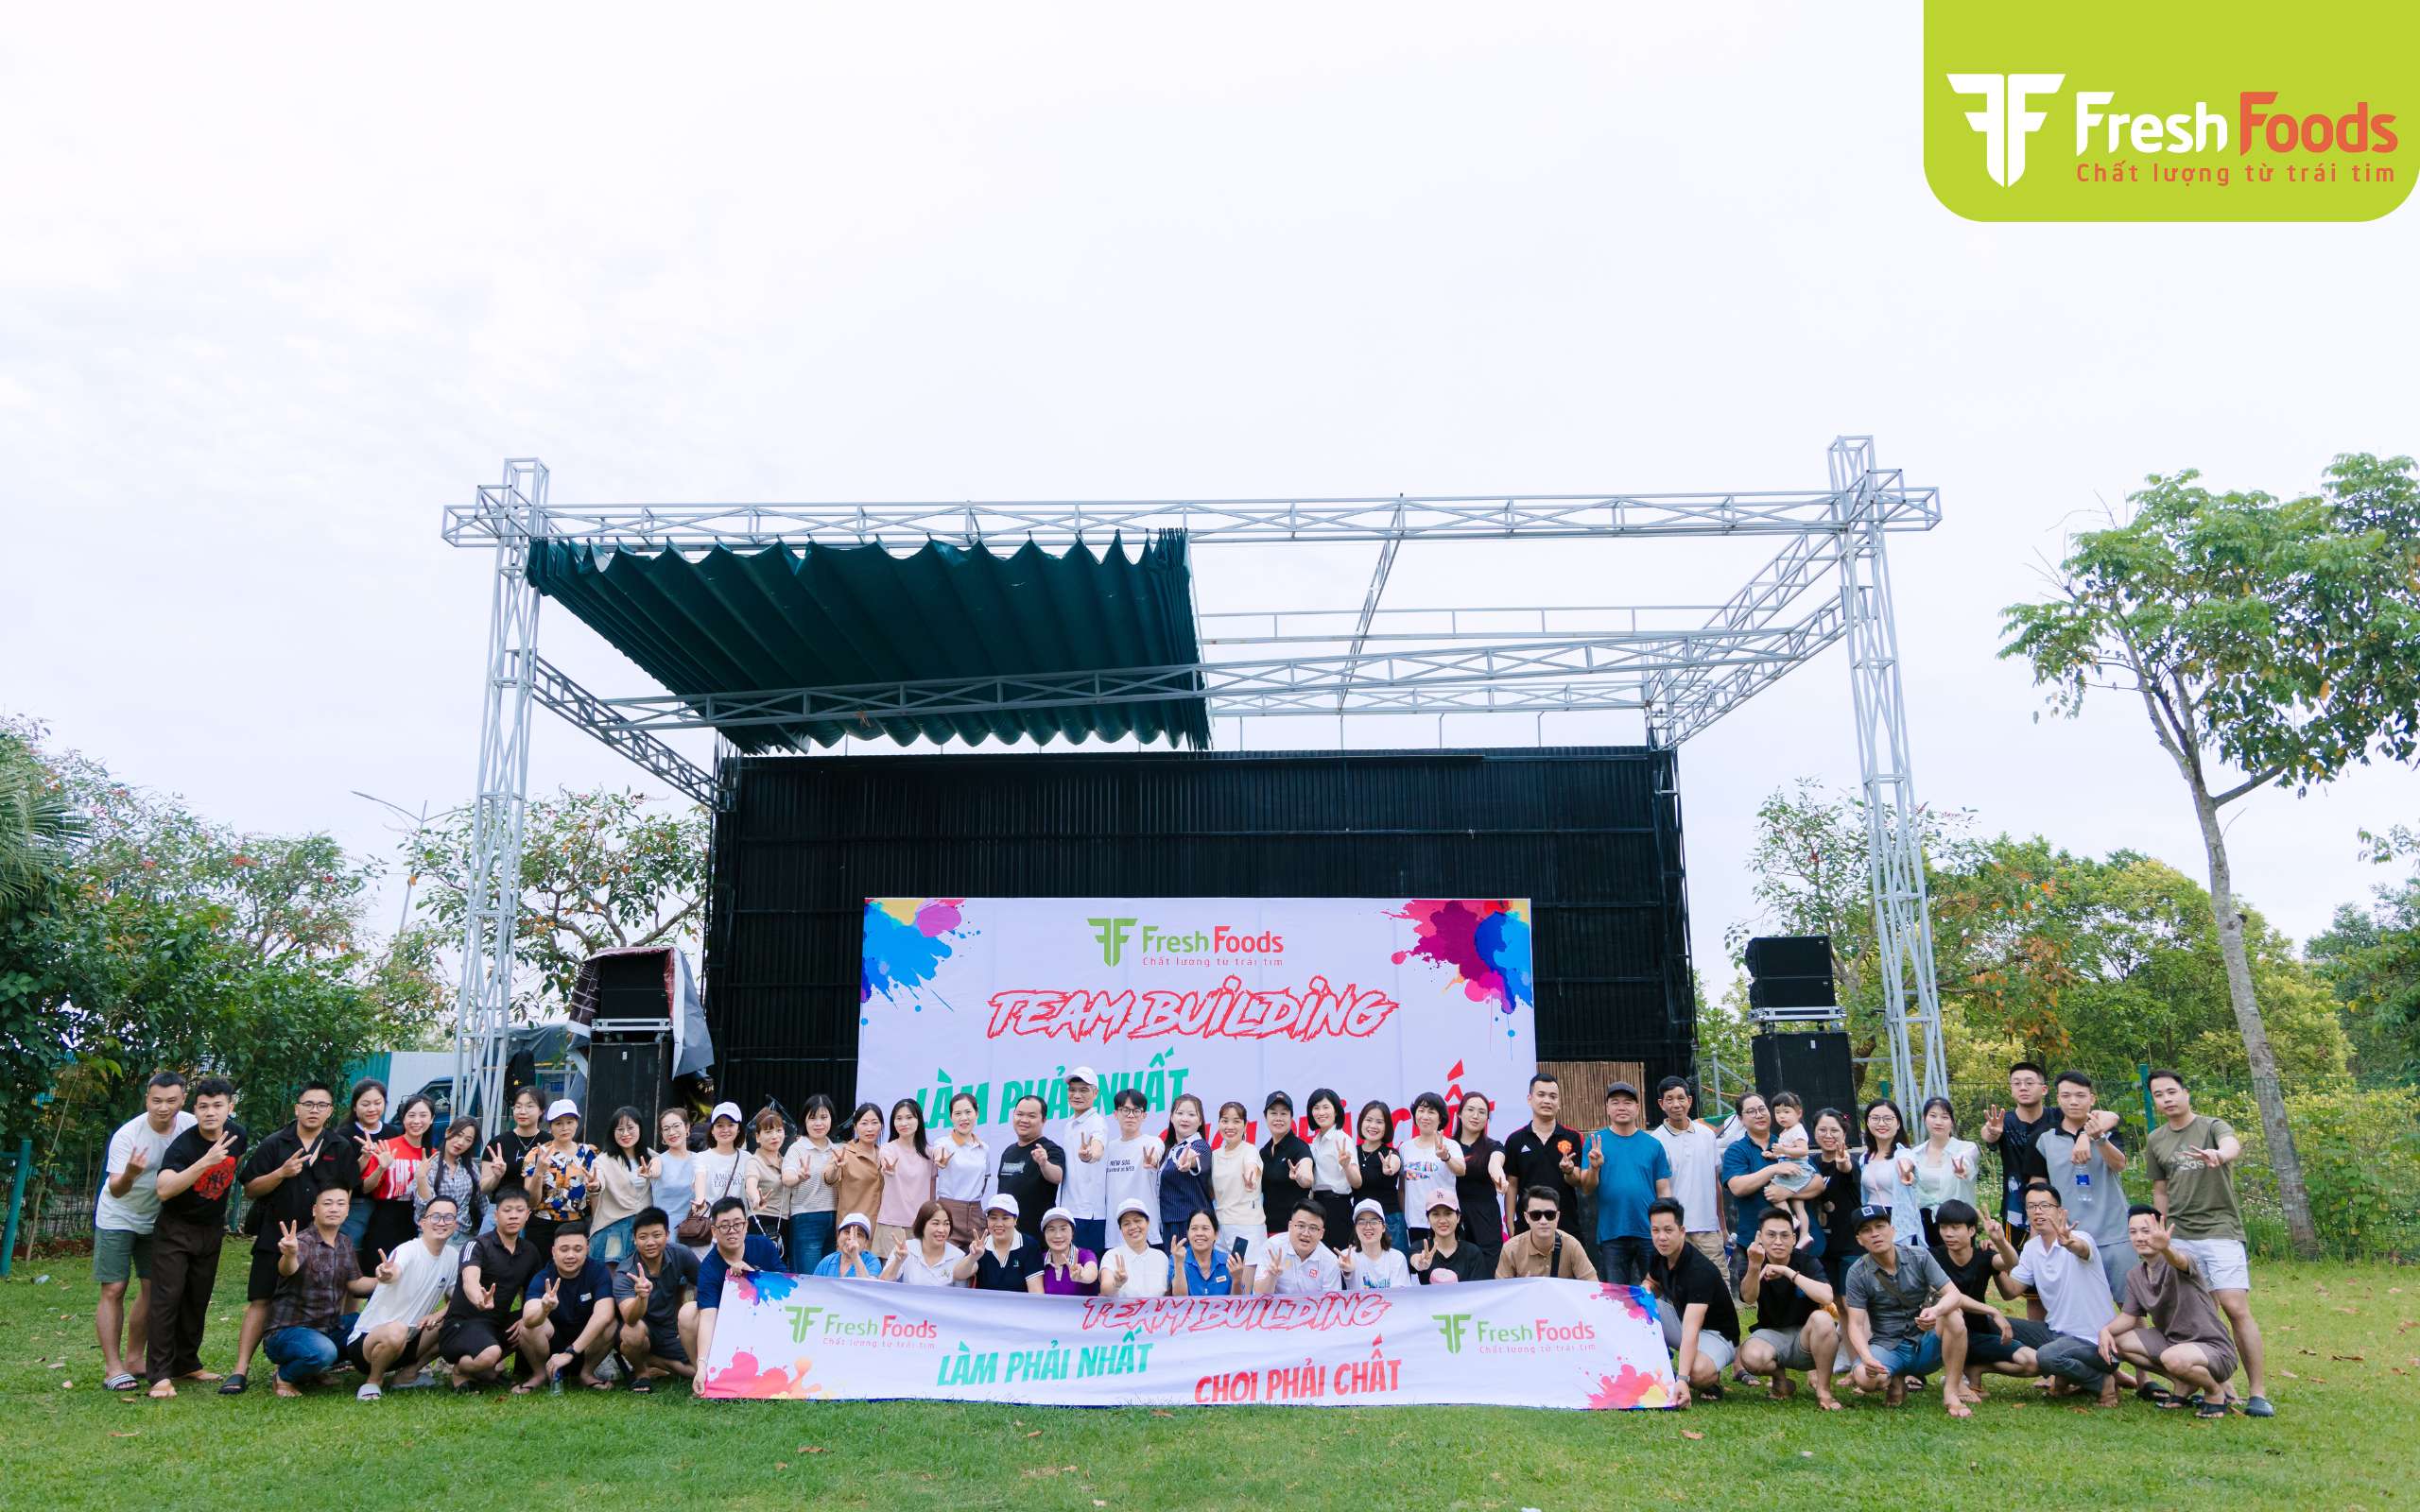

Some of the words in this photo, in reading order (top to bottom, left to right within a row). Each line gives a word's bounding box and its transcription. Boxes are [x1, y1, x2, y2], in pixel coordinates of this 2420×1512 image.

[987, 989, 1136, 1044] TEAM
[937, 1340, 999, 1386] LÀM
[1004, 1340, 1070, 1383] PHẢI
[1077, 1321, 1154, 1378] NHẤT
[1266, 1357, 1325, 1400] PHẢI
[1334, 1332, 1402, 1396] CHẤT
